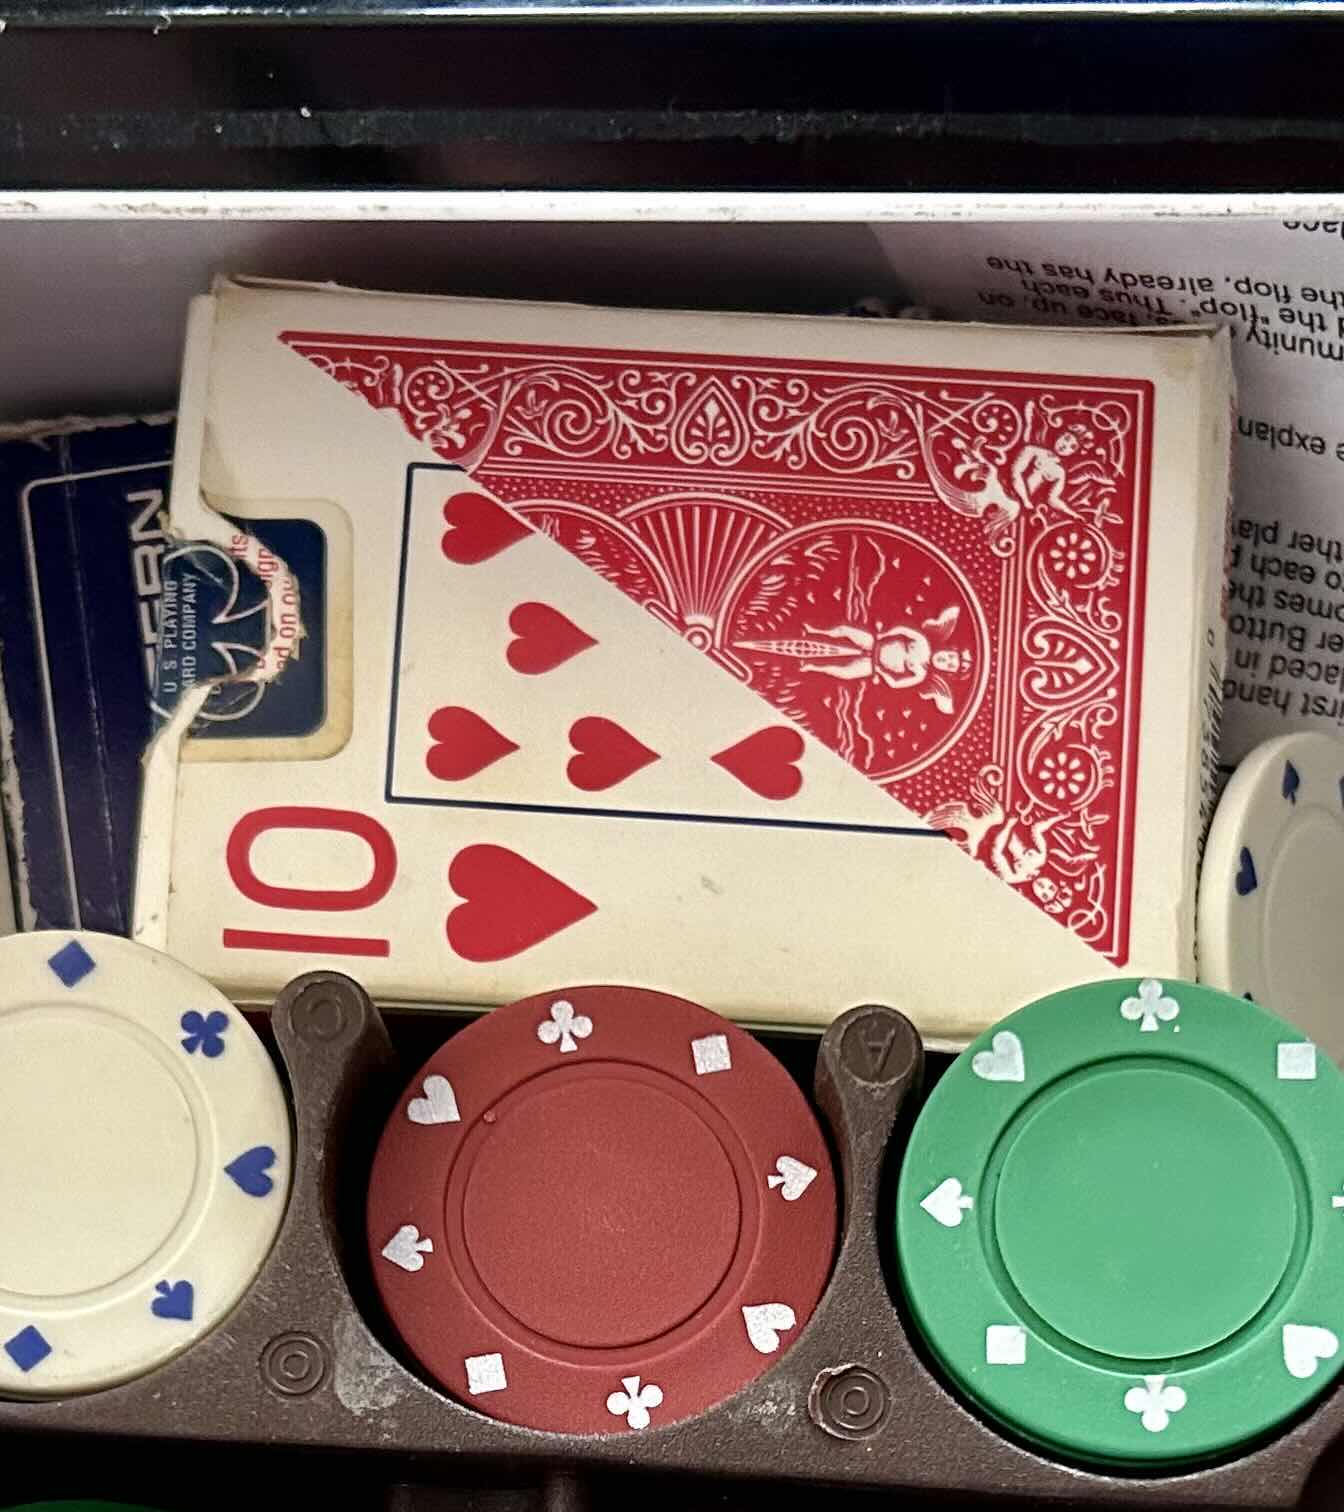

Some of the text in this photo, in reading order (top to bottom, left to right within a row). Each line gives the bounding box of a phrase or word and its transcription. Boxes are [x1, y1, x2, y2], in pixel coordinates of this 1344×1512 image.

[985, 256, 1032, 276] the
[1041, 262, 1094, 286] has
[1022, 280, 1090, 300] each
[1104, 268, 1213, 297] already
[1223, 275, 1290, 304] flop,
[1099, 288, 1171, 317] Thus
[1279, 307, 1327, 332] the
[1251, 552, 1316, 586] each
[163, 580, 178, 649] PLAYING
[181, 573, 201, 650] COMPANY
[1234, 650, 1258, 678] in
[222, 805, 398, 957] 10
